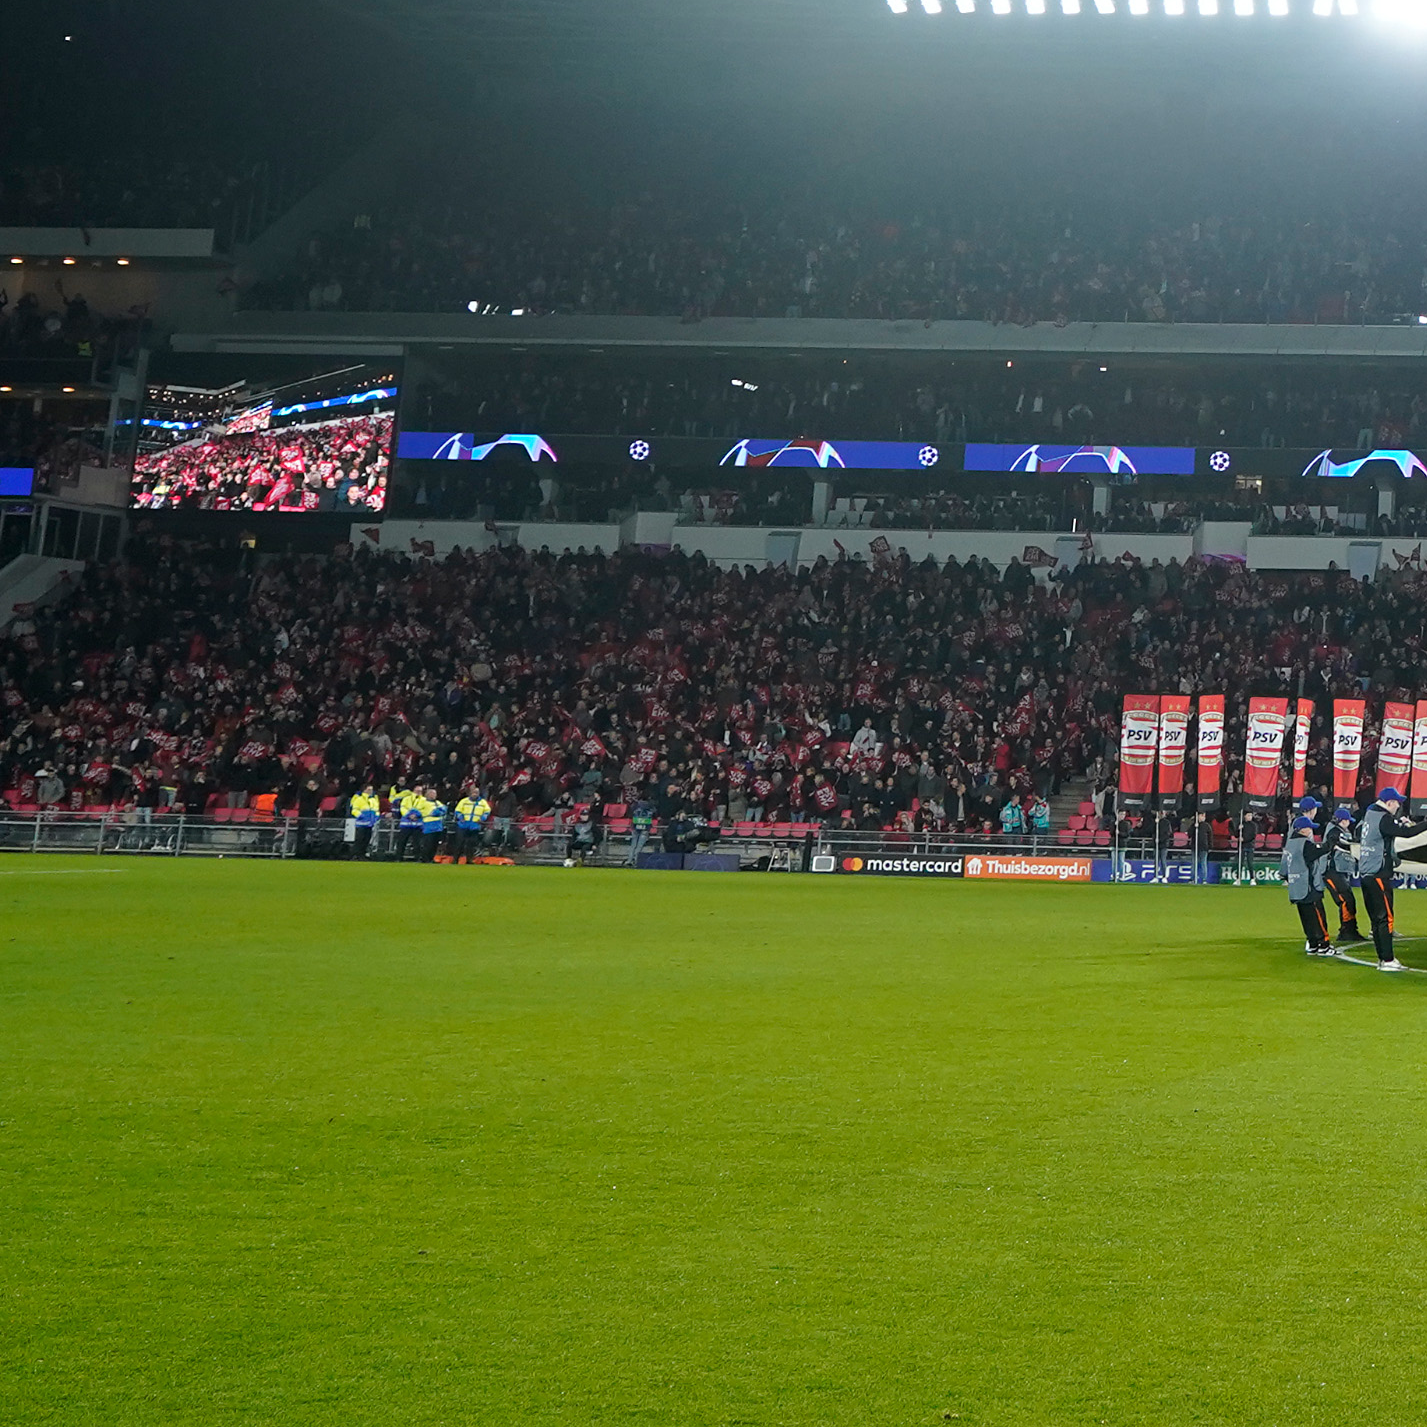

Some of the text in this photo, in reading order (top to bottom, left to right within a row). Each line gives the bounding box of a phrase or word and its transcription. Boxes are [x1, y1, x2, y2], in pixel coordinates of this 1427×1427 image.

[1127, 729, 1153, 741] PSV
[1164, 731, 1181, 742] PSV
[1201, 730, 1219, 741] PSV
[1252, 731, 1278, 744] PSV
[1338, 735, 1358, 746] PSV
[1384, 736, 1410, 750] PSV
[867, 858, 962, 873] mastercard
[986, 860, 1091, 879] Thuisbezorgd.nl
[1141, 864, 1192, 881] PS5
[1221, 867, 1281, 881] Heineke
